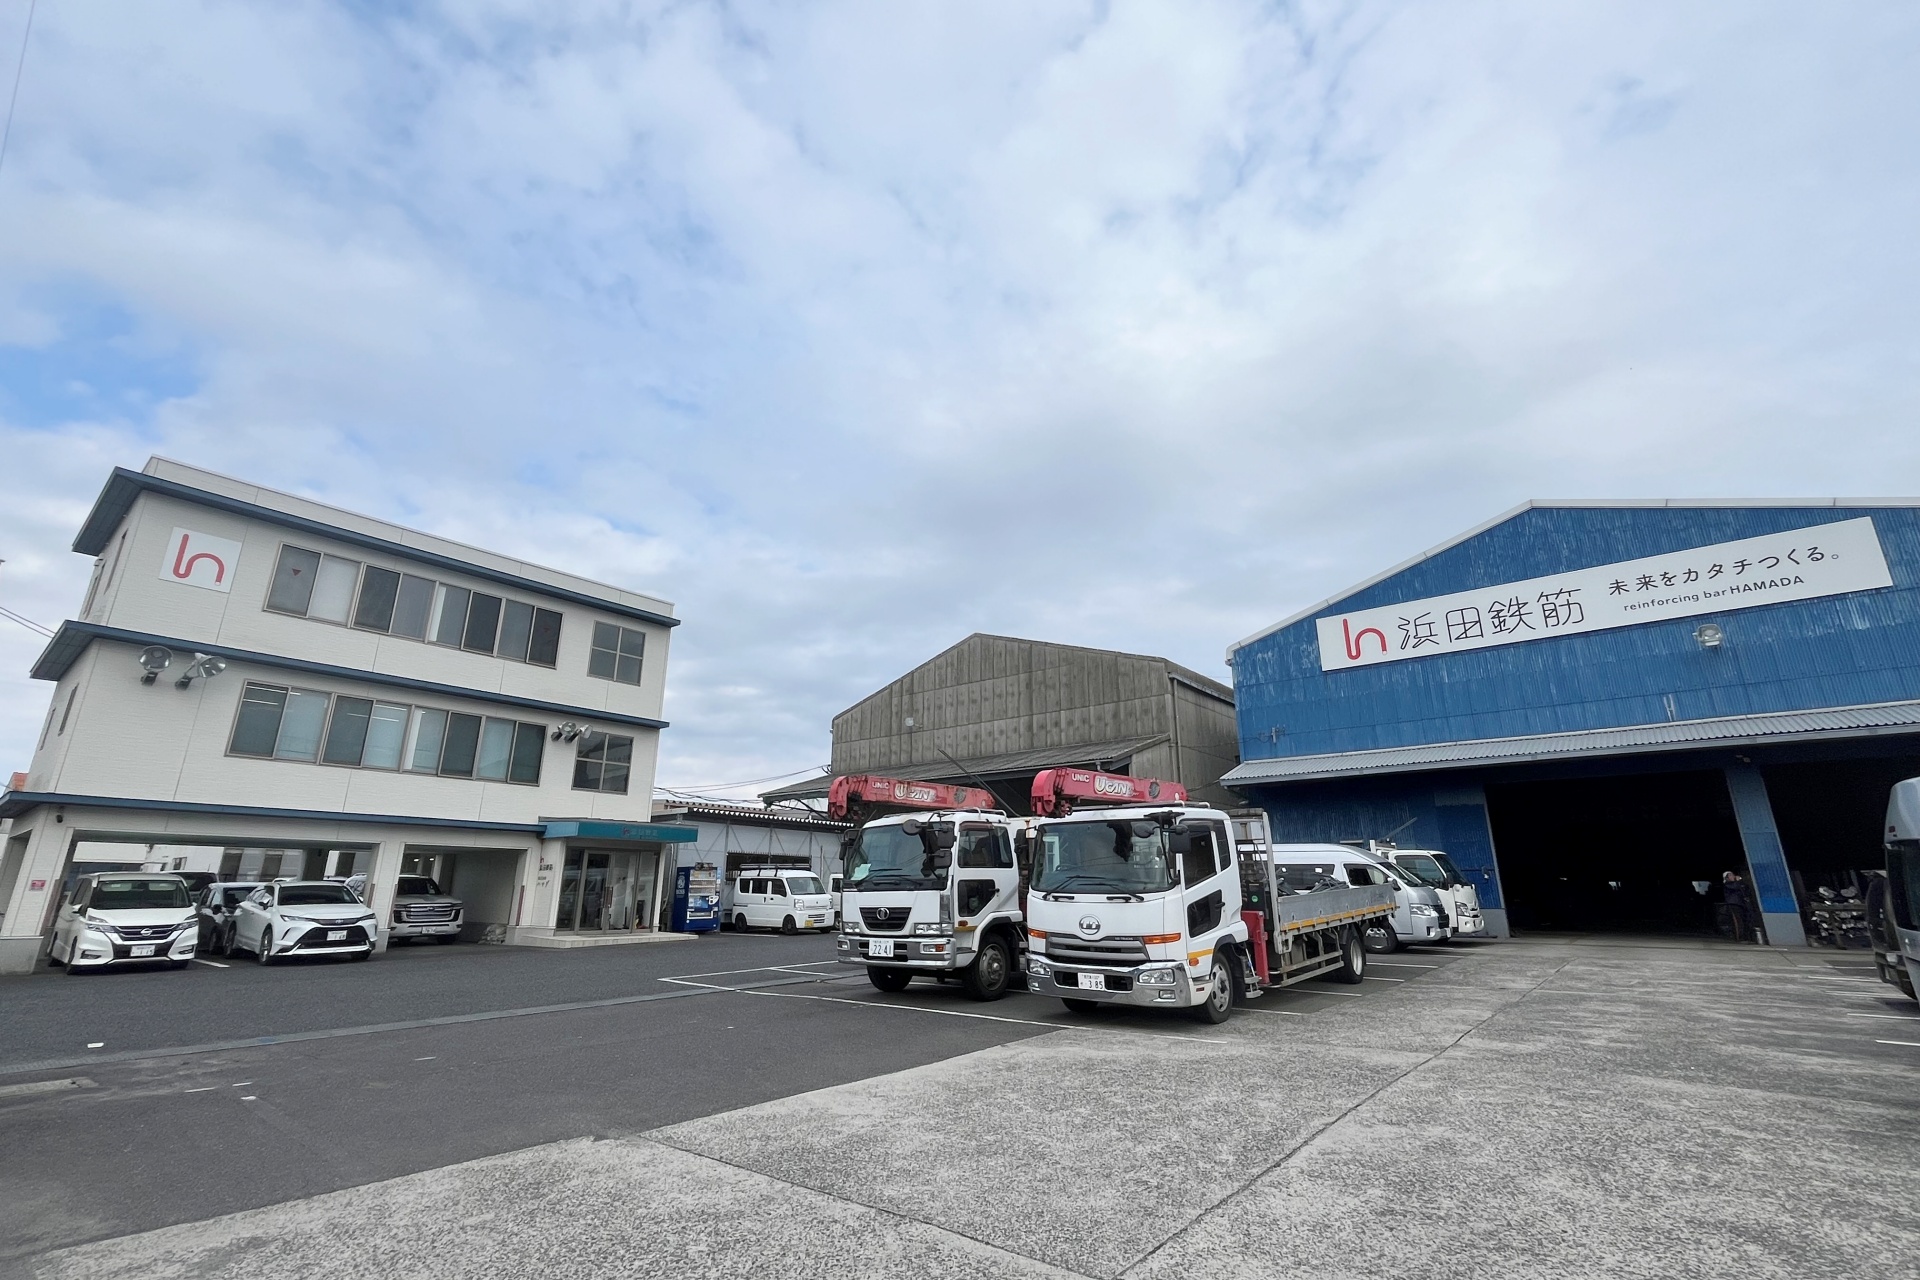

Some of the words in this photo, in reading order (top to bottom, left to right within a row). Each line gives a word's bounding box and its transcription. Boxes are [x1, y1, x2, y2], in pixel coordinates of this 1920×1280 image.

[1608, 546, 1840, 597] 未来をカタチつくる。
[1623, 592, 1700, 612] reinforcing
[1703, 588, 1729, 600] bar
[1729, 574, 1805, 595] HAMADA
[1397, 588, 1585, 650] 浜田鉄筋
[872, 781, 889, 789] UNIC
[1071, 773, 1090, 783] UNIC
